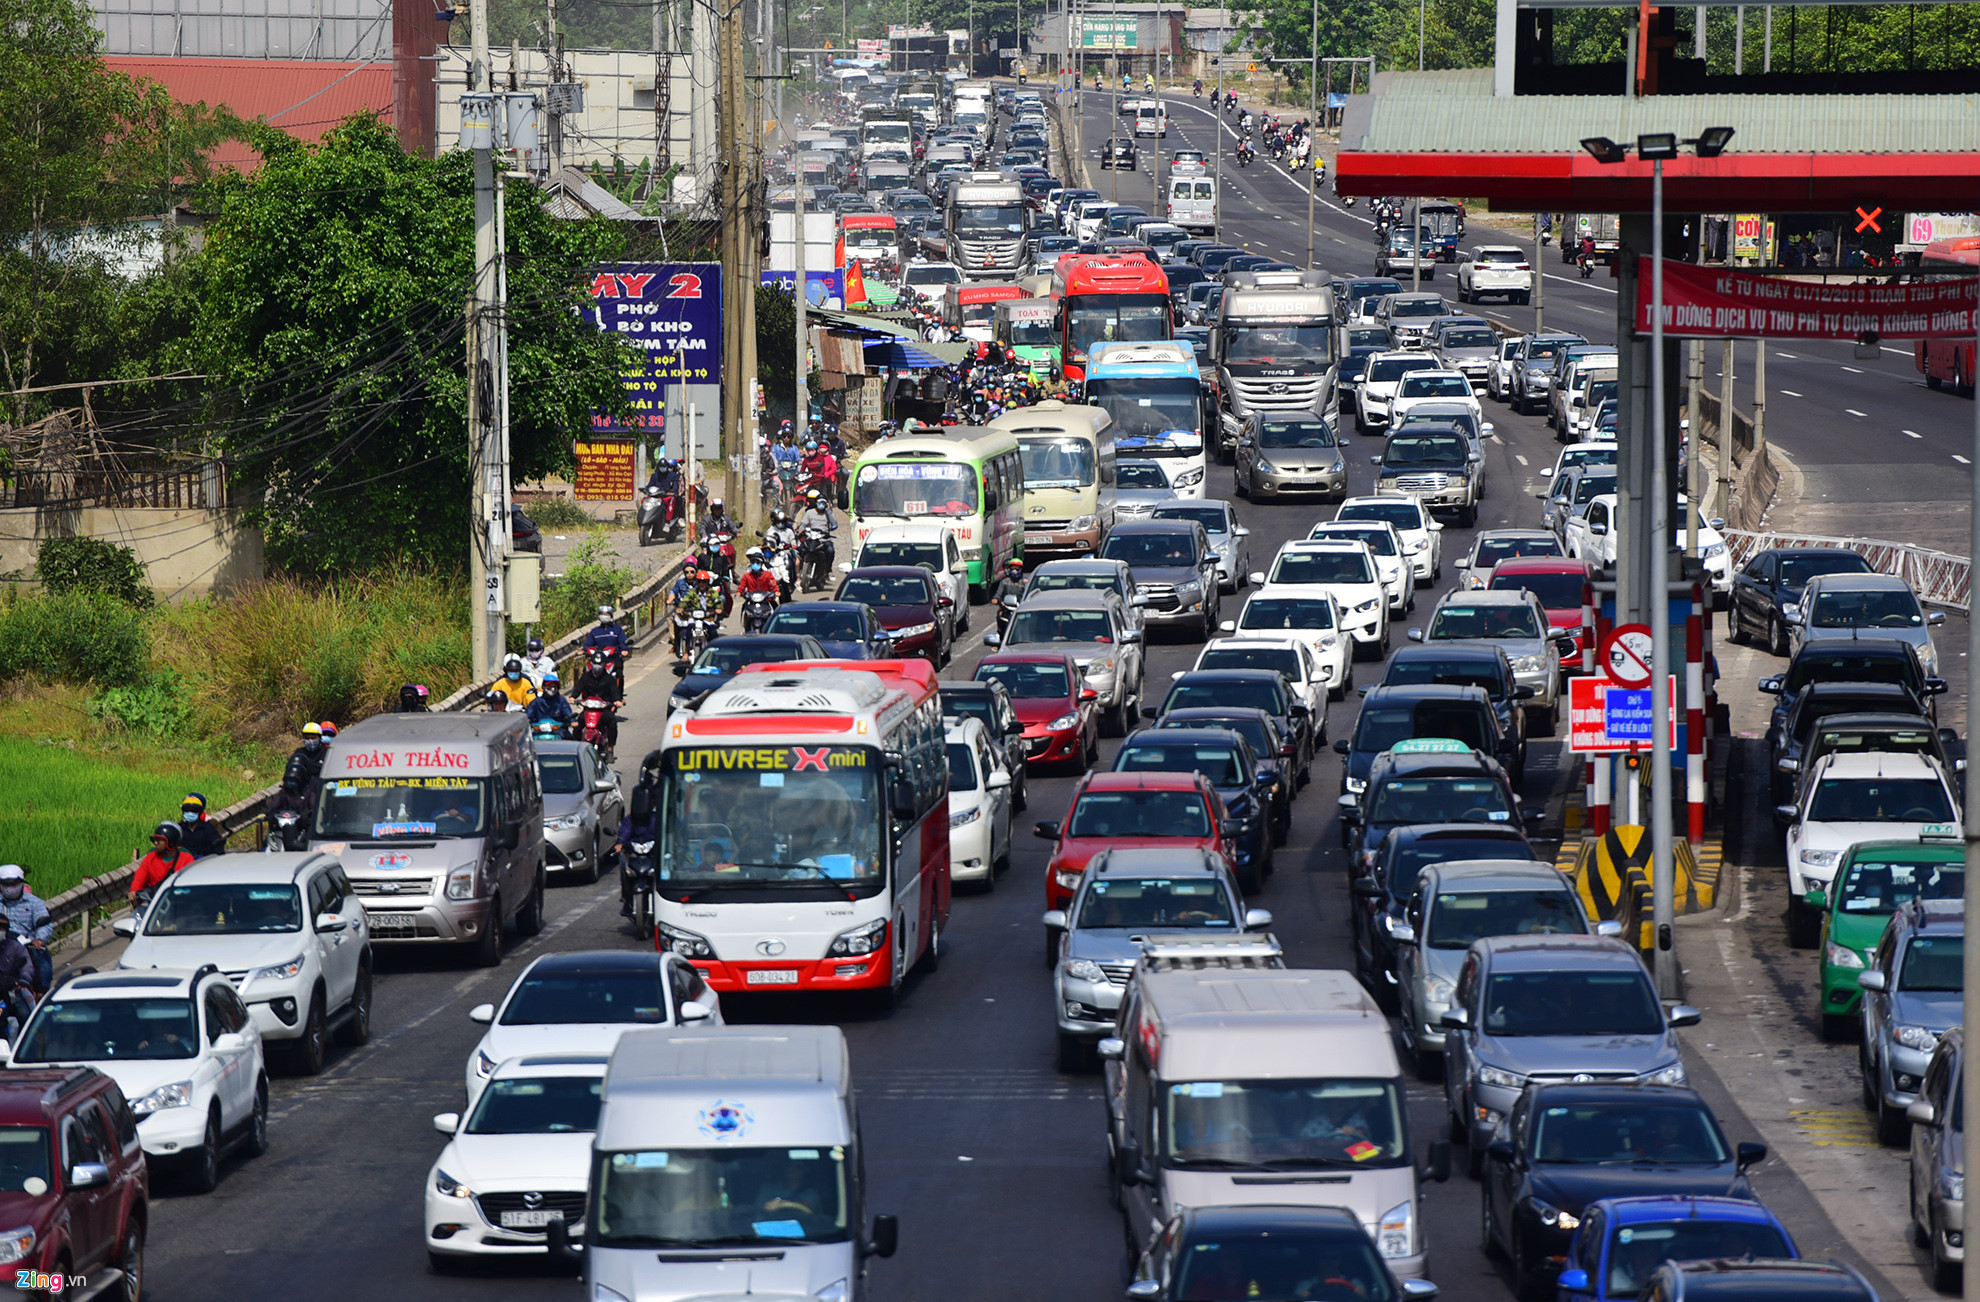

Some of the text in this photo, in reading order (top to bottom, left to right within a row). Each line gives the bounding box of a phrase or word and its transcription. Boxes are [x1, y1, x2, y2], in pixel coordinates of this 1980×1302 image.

[1912, 218, 1933, 242] 69
[666, 272, 702, 299] 2
[963, 292, 989, 301] KUMHO
[1755, 281, 1791, 300] NGÀY
[1793, 286, 1866, 303] 01/12/2018
[1869, 288, 1906, 306] TRẠM
[1910, 287, 1935, 301] THU
[1938, 283, 1962, 300] PHÍ
[1018, 308, 1039, 318] TOÀN
[1247, 303, 1308, 313] HYUNDAI
[1645, 303, 1674, 326] TM
[1676, 301, 1712, 328] DỪNG
[1715, 307, 1746, 333] DỊCH
[1750, 309, 1767, 335] VỤ
[1770, 310, 1795, 331] THU
[1797, 309, 1820, 332] PHÍ
[1823, 312, 1840, 336] TỰ
[1883, 310, 1928, 332] KHÔNG
[651, 320, 693, 333] KHO
[654, 355, 676, 367] HỘP
[907, 503, 926, 512] 611
[487, 594, 497, 604] A
[345, 746, 469, 770] TOÀN THẮNG
[678, 747, 866, 771] UNIVRSE X mini
[352, 777, 376, 788] VŨNG
[378, 776, 396, 788] TÀU
